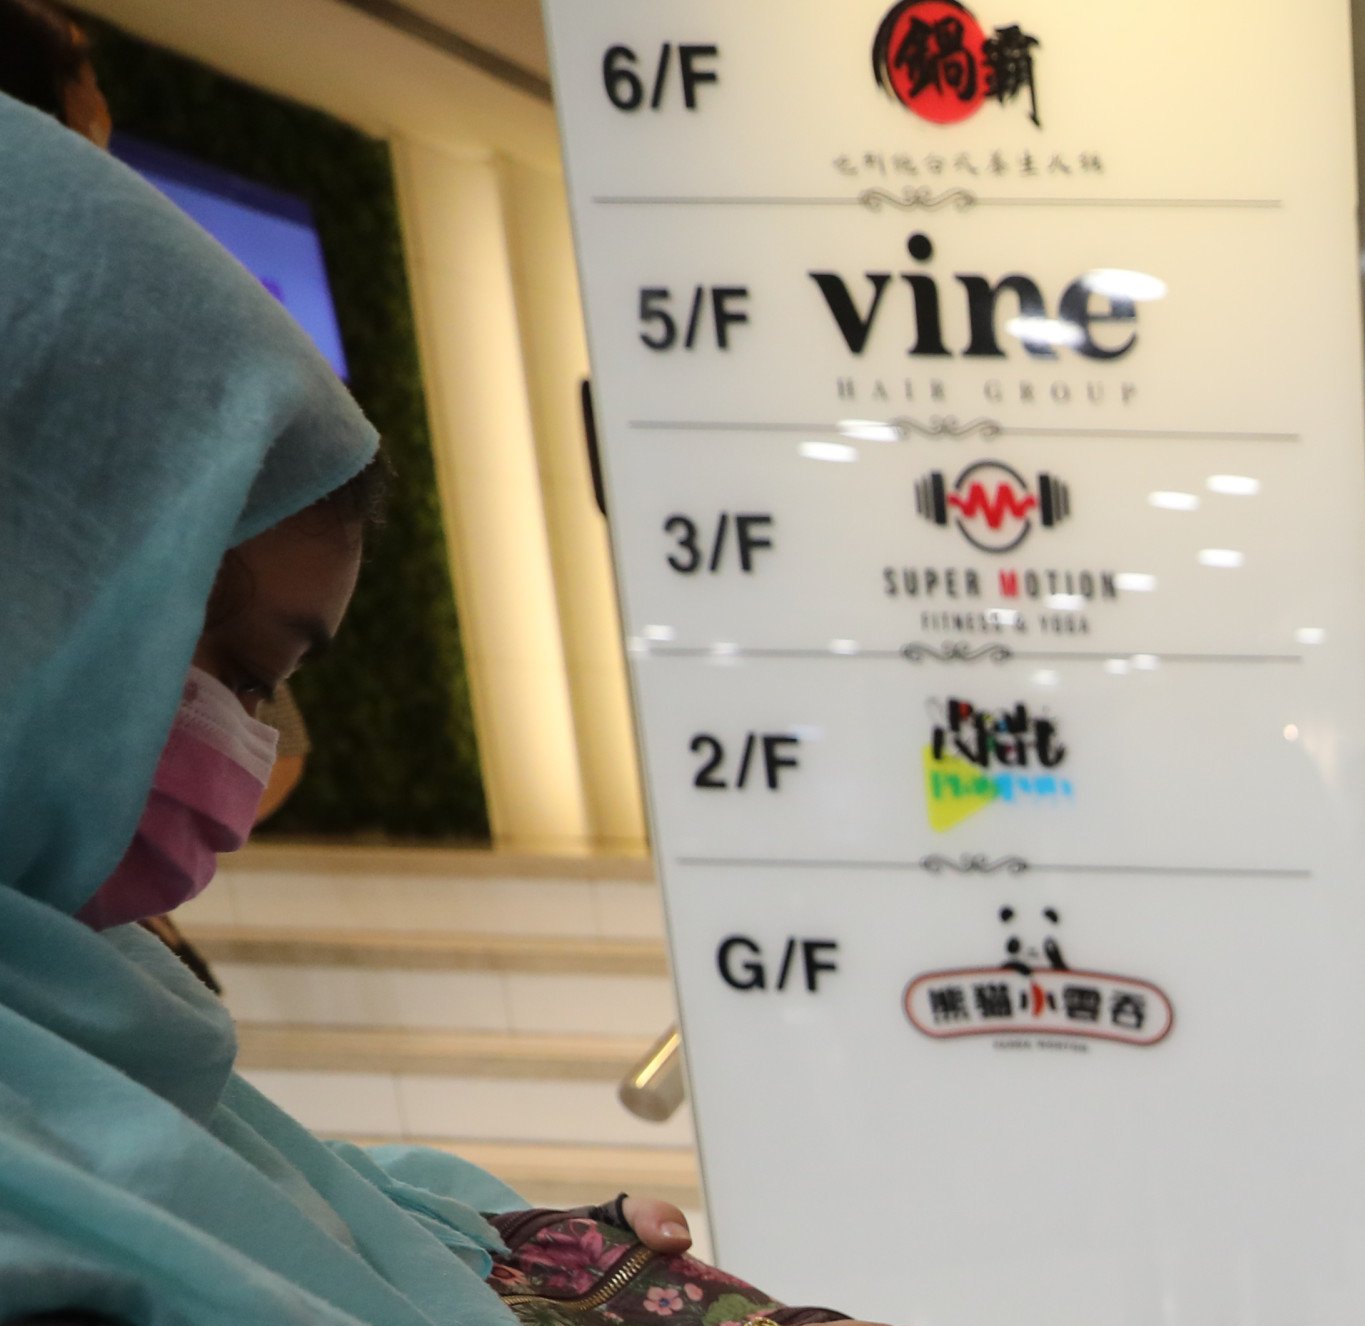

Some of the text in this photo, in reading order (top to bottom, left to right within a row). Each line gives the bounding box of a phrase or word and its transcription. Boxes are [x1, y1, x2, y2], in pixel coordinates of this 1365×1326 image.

[602, 43, 719, 111] 6/F
[638, 286, 750, 351] 5/F
[808, 233, 1139, 360] vine
[836, 378, 1139, 405] HAIR GROUP
[664, 514, 774, 574] 3/F
[883, 567, 1118, 600] SUPER MOTION
[689, 733, 799, 790] 2/F
[716, 936, 838, 993] G/F
